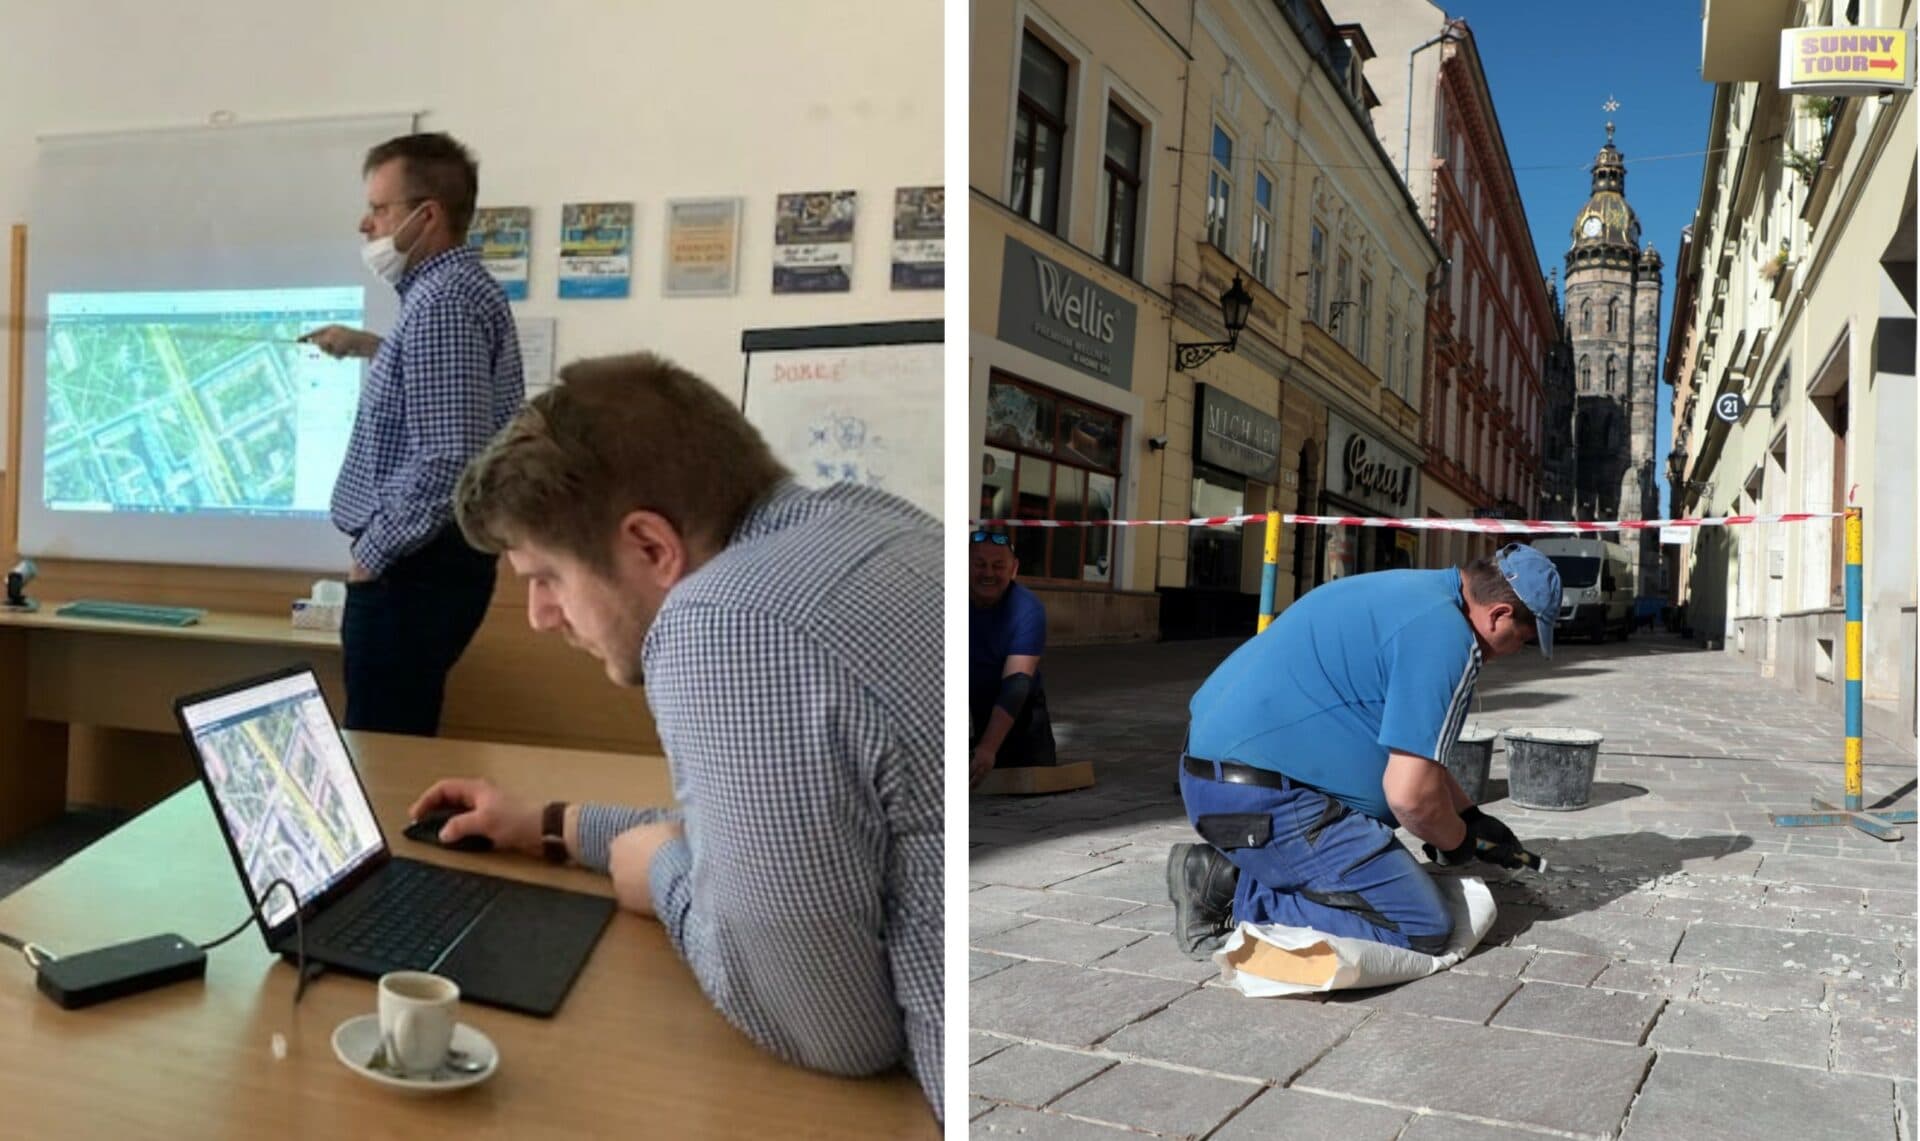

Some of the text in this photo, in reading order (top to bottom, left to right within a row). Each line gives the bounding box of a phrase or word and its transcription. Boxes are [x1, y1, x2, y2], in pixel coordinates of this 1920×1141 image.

[1801, 35, 1896, 54] SUNNY
[1801, 55, 1869, 74] TOUR
[1034, 256, 1115, 344] Wellis
[1723, 400, 1738, 414] 21
